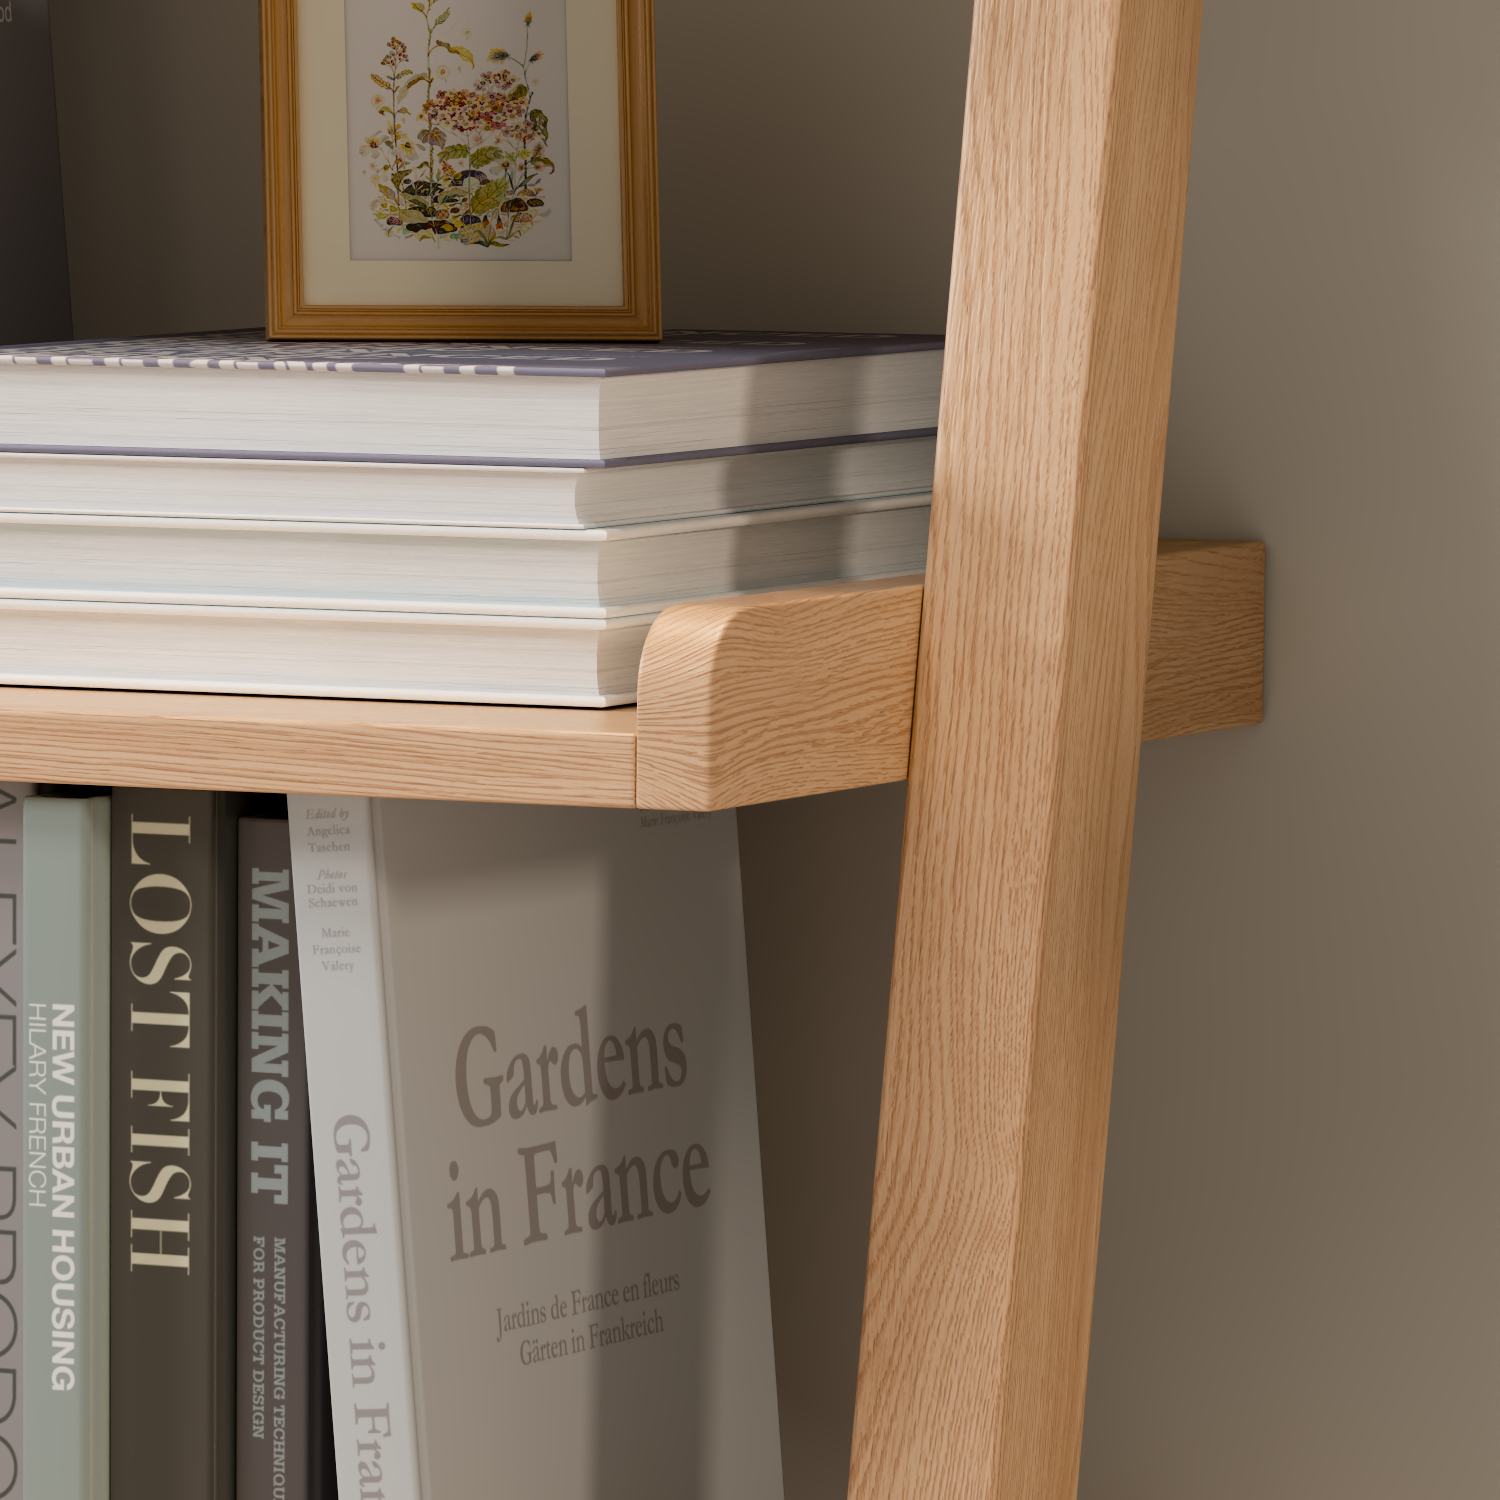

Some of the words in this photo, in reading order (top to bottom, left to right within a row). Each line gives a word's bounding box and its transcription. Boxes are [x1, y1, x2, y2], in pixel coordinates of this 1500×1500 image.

[305, 808, 336, 820] Edited
[339, 807, 350, 821] by
[306, 824, 351, 839] Angelica
[307, 841, 351, 853] Taschen
[307, 882, 336, 894] Deidi
[338, 884, 358, 893] von
[317, 869, 348, 880] Photos
[128, 813, 193, 1050] LOST
[312, 944, 362, 957] Françoise
[321, 927, 350, 938] Marie
[321, 960, 355, 973] Valery
[250, 867, 290, 1123] MAKING
[28, 1002, 47, 1095] HILARY
[51, 1003, 76, 1086] NEW
[454, 1004, 688, 1128] Gardens
[28, 1103, 47, 1208] FRENCH
[51, 1095, 76, 1219] URBAN
[128, 1070, 193, 1276] FISH
[250, 1141, 289, 1206] IT
[333, 1113, 378, 1324] Gardens
[446, 1160, 507, 1263] in
[517, 1140, 712, 1247] France
[253, 1235, 266, 1274] FOR
[51, 1229, 76, 1392] HOUSING
[253, 1277, 266, 1366] PRODUCT
[273, 1236, 286, 1401] MANUFACTURING
[496, 1301, 547, 1343] Jardins
[550, 1294, 568, 1321] de
[570, 1286, 619, 1317] France
[622, 1281, 641, 1303] en
[642, 1271, 681, 1299] fleurs
[519, 1336, 569, 1366] Gärten
[571, 1328, 586, 1354] in
[588, 1308, 665, 1351] Frankreich
[348, 1337, 387, 1389] in
[252, 1369, 265, 1440] DESIGN
